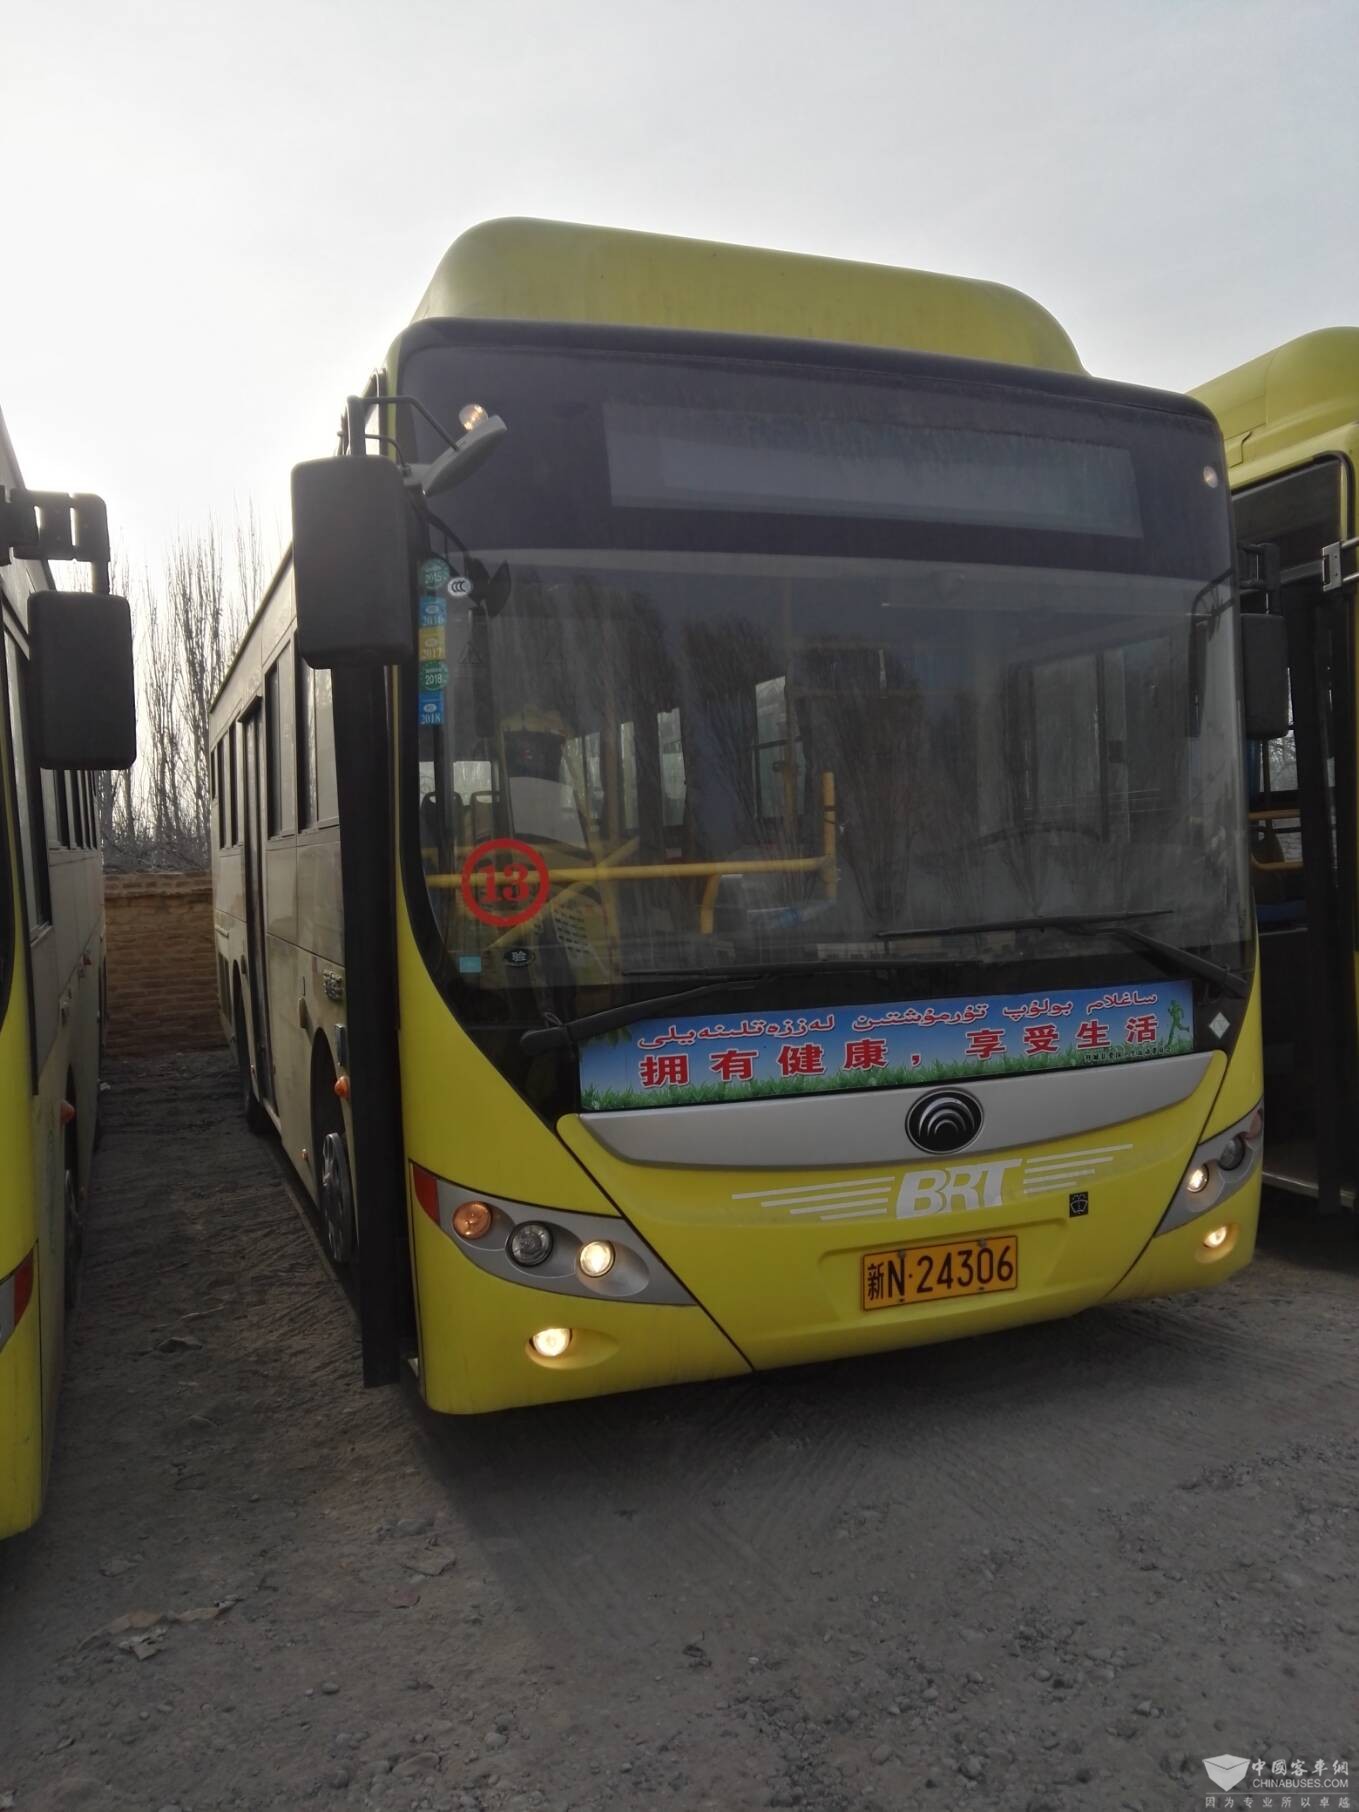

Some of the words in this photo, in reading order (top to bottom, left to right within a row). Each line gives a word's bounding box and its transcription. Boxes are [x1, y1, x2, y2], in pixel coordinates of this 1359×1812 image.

[425, 674, 442, 685] 2018
[479, 862, 531, 903] 13
[896, 1158, 1023, 1220] BRT
